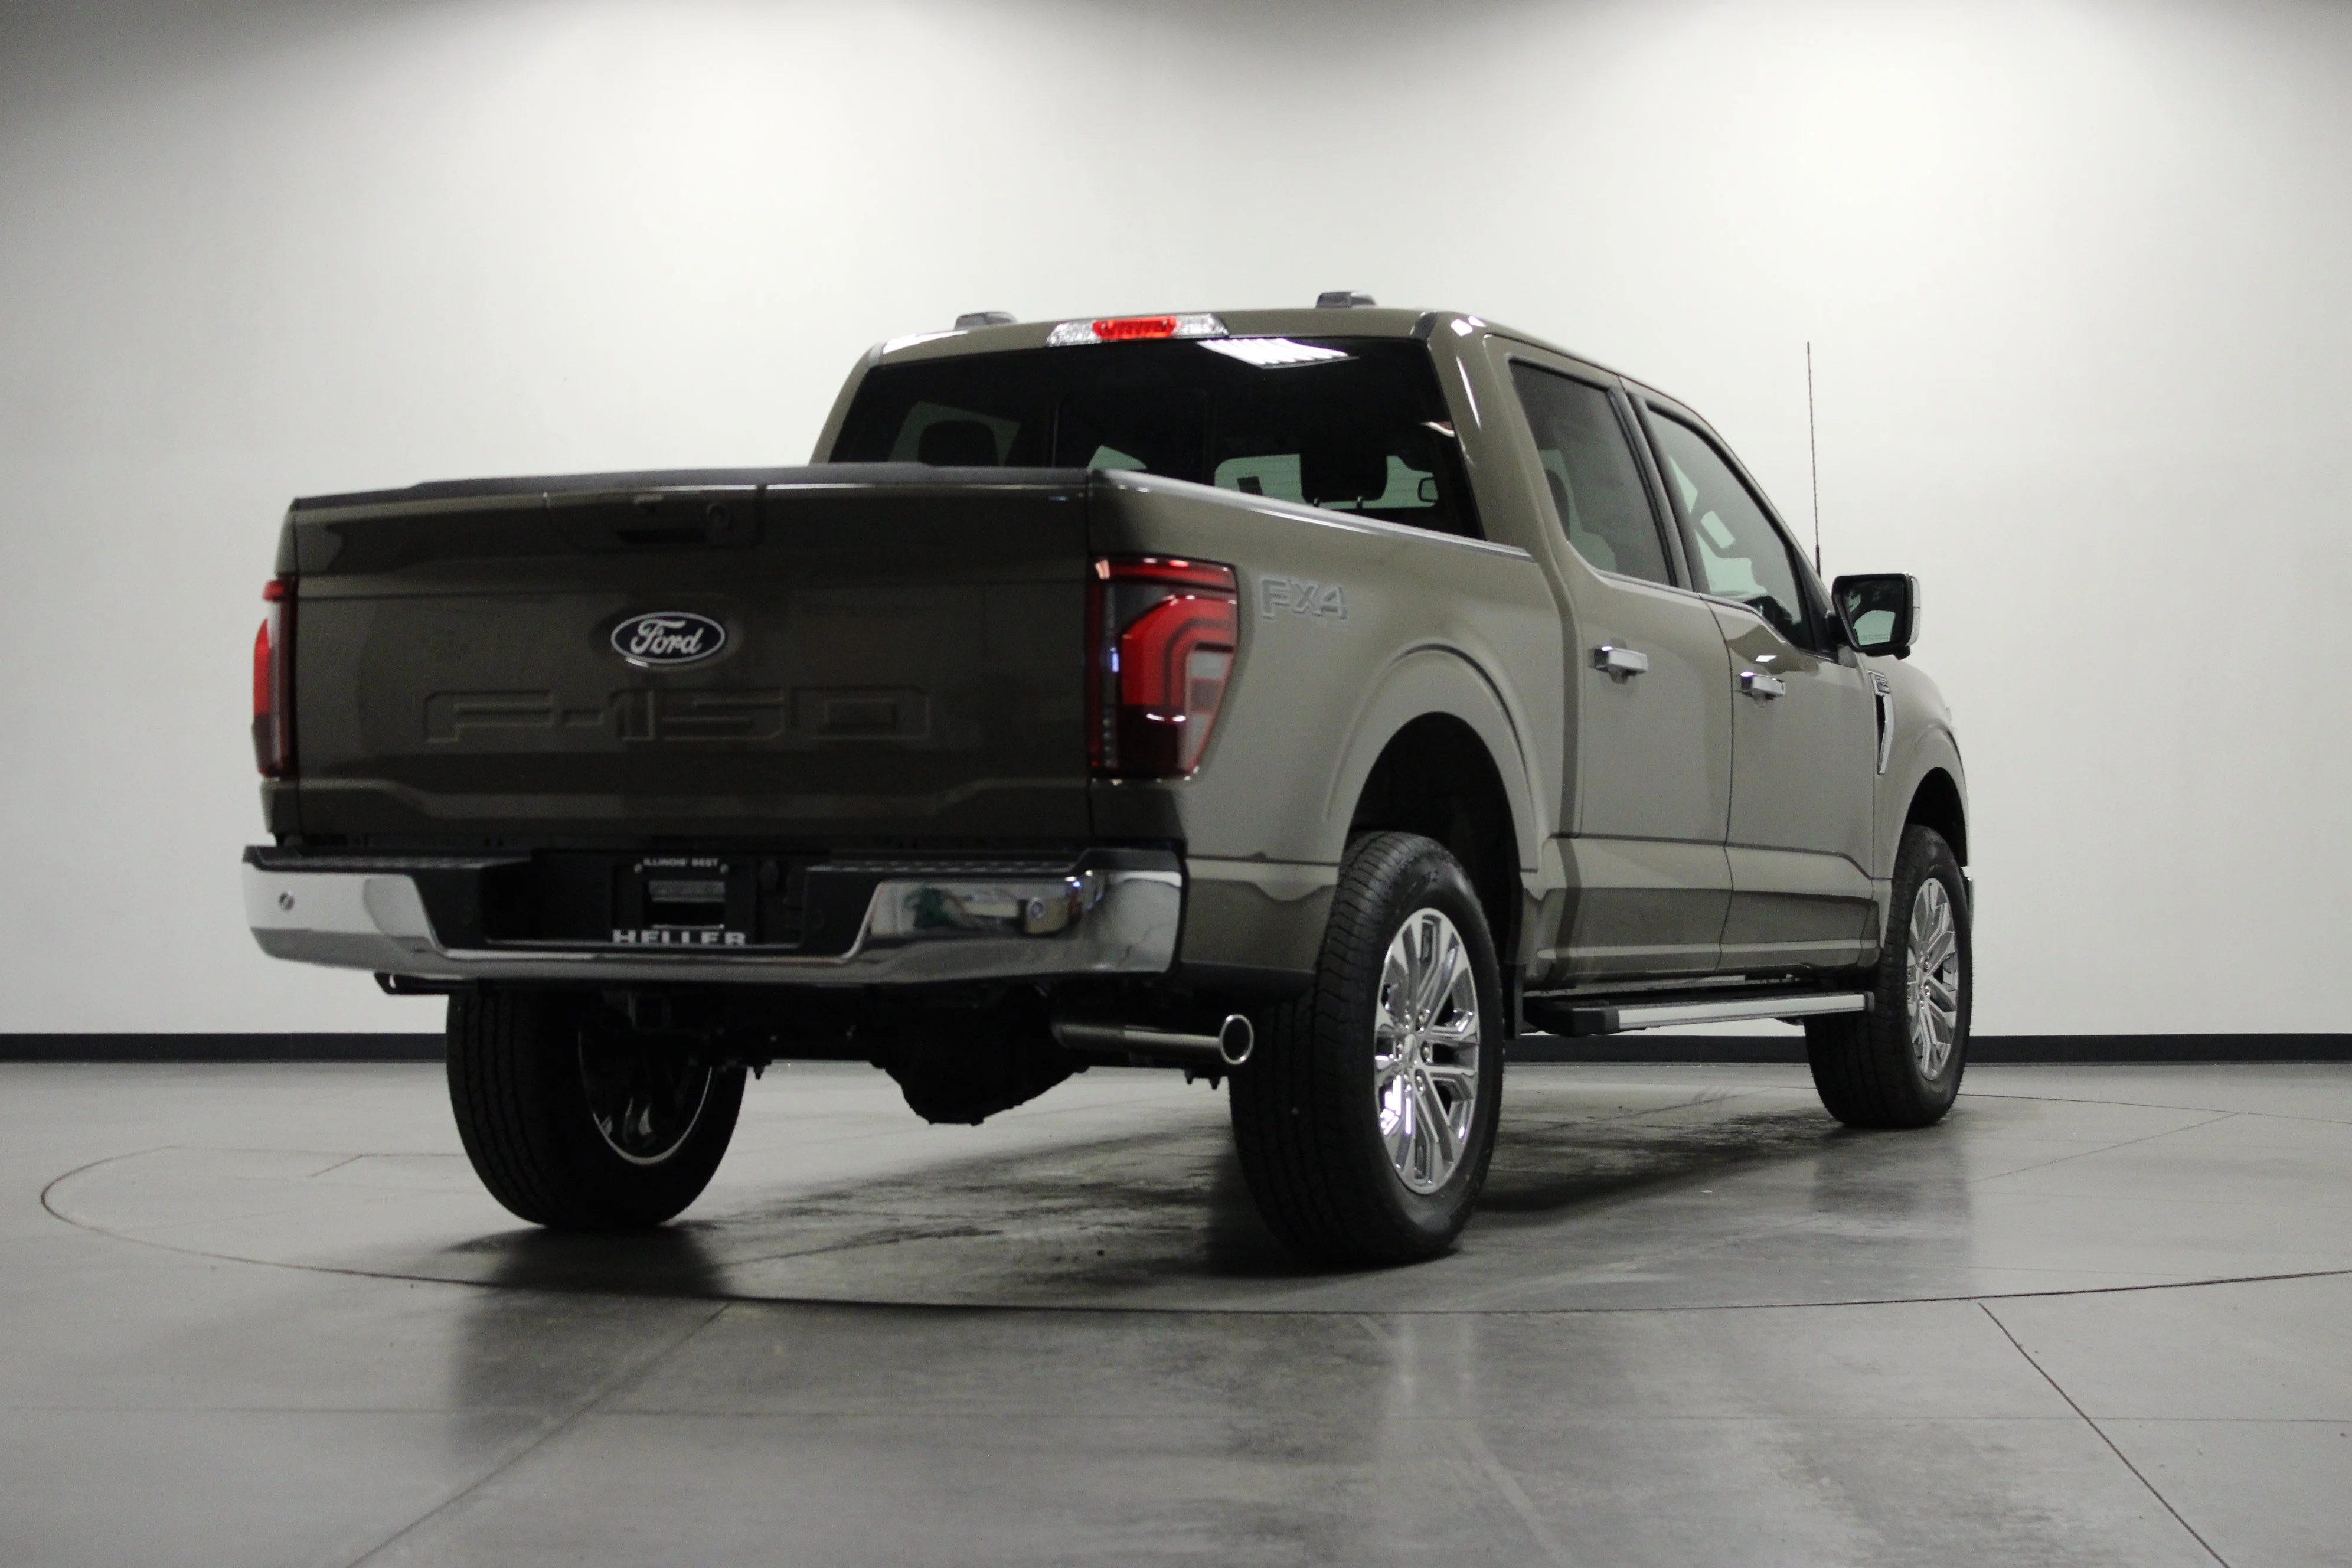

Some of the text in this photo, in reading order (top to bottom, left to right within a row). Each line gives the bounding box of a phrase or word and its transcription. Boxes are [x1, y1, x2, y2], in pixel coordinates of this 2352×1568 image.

[1260, 574, 1349, 621] FX4
[629, 617, 704, 655] Ford
[423, 687, 932, 743] F-150
[691, 857, 718, 867] BEST
[612, 929, 746, 946] HELLER
